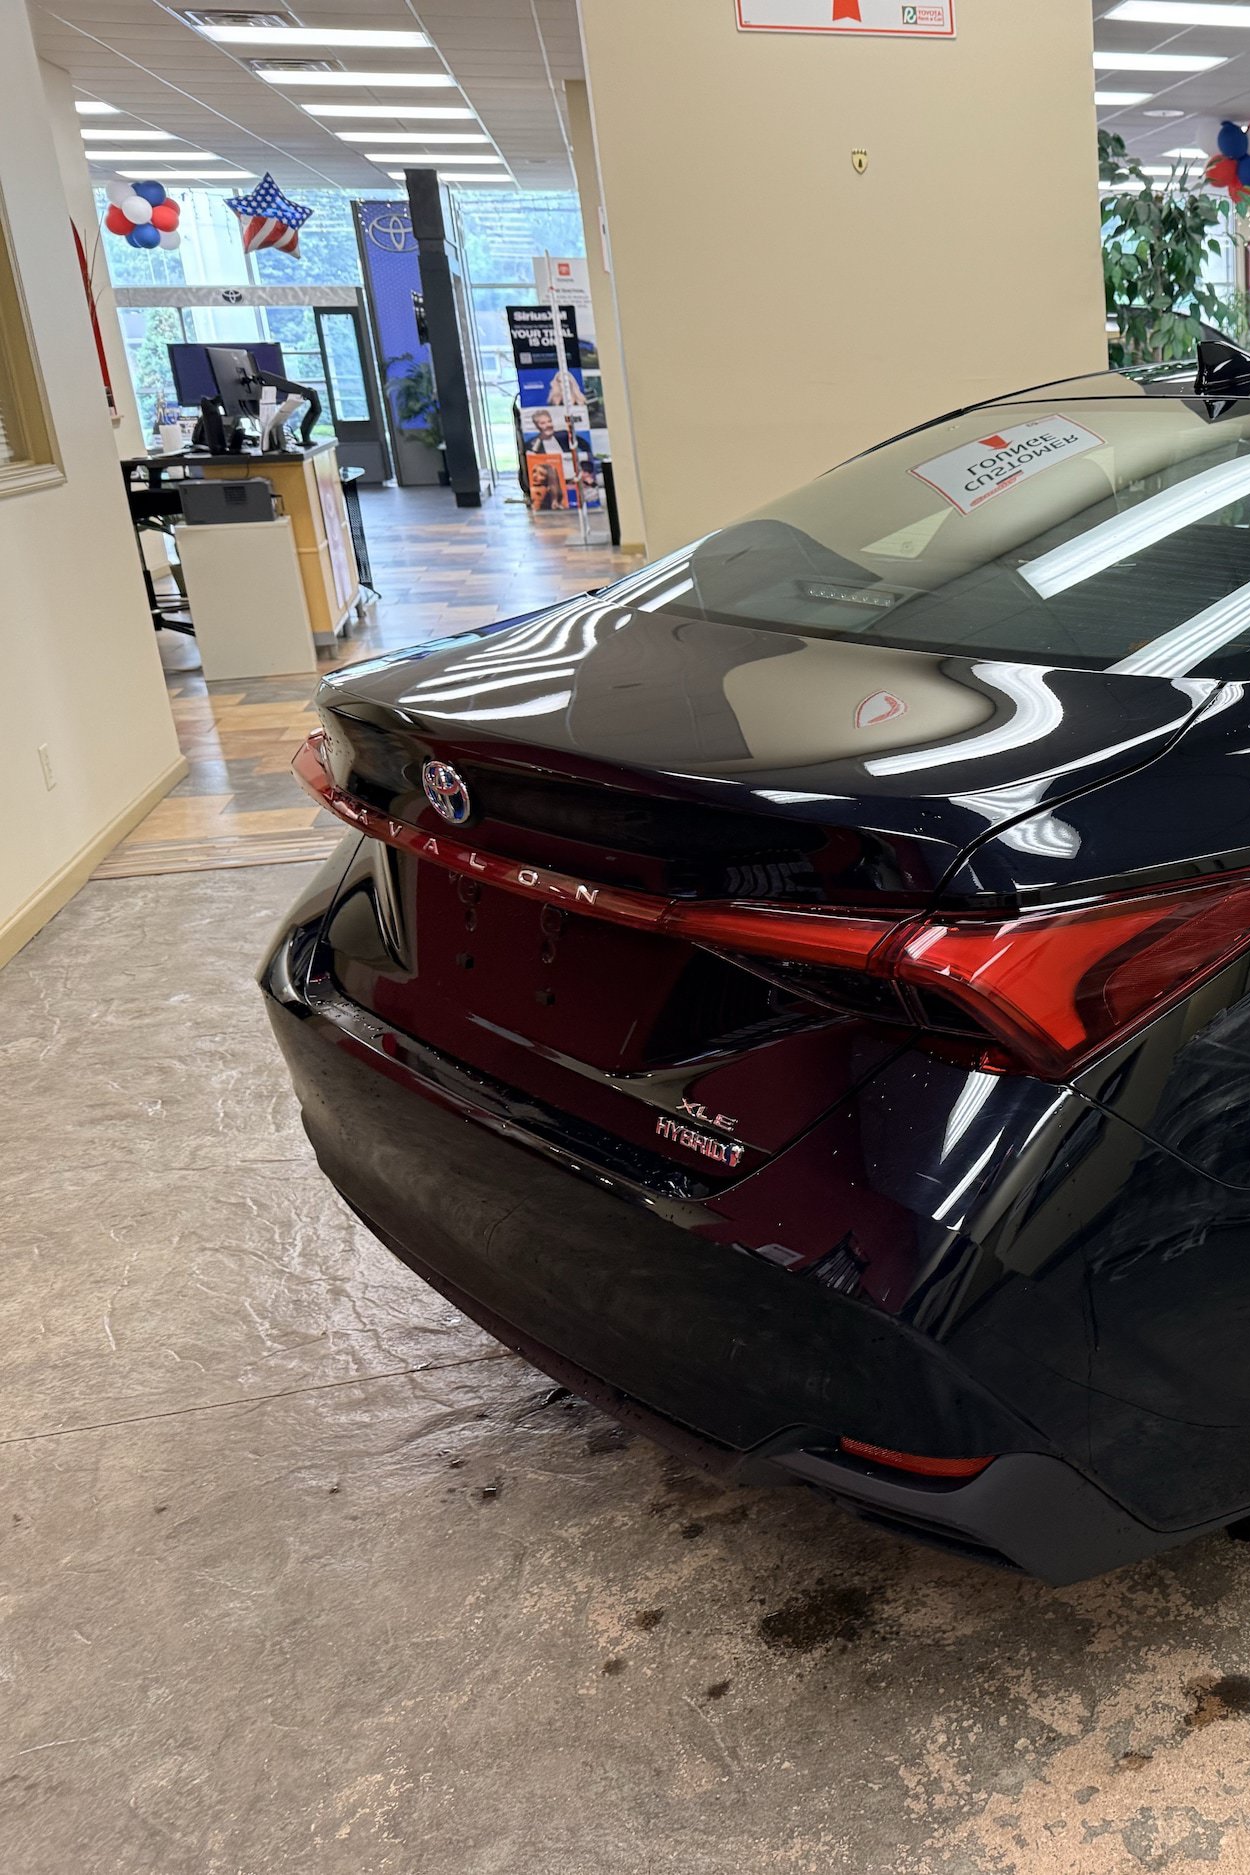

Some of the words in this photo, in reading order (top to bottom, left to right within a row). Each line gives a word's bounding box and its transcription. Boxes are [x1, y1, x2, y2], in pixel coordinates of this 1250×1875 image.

[511, 328, 542, 339] YOUR
[542, 328, 575, 338] TRAL
[528, 337, 540, 347] IS
[355, 808, 600, 905] AVALON
[675, 1097, 739, 1132] XLE
[655, 1116, 727, 1162] HYBRID
